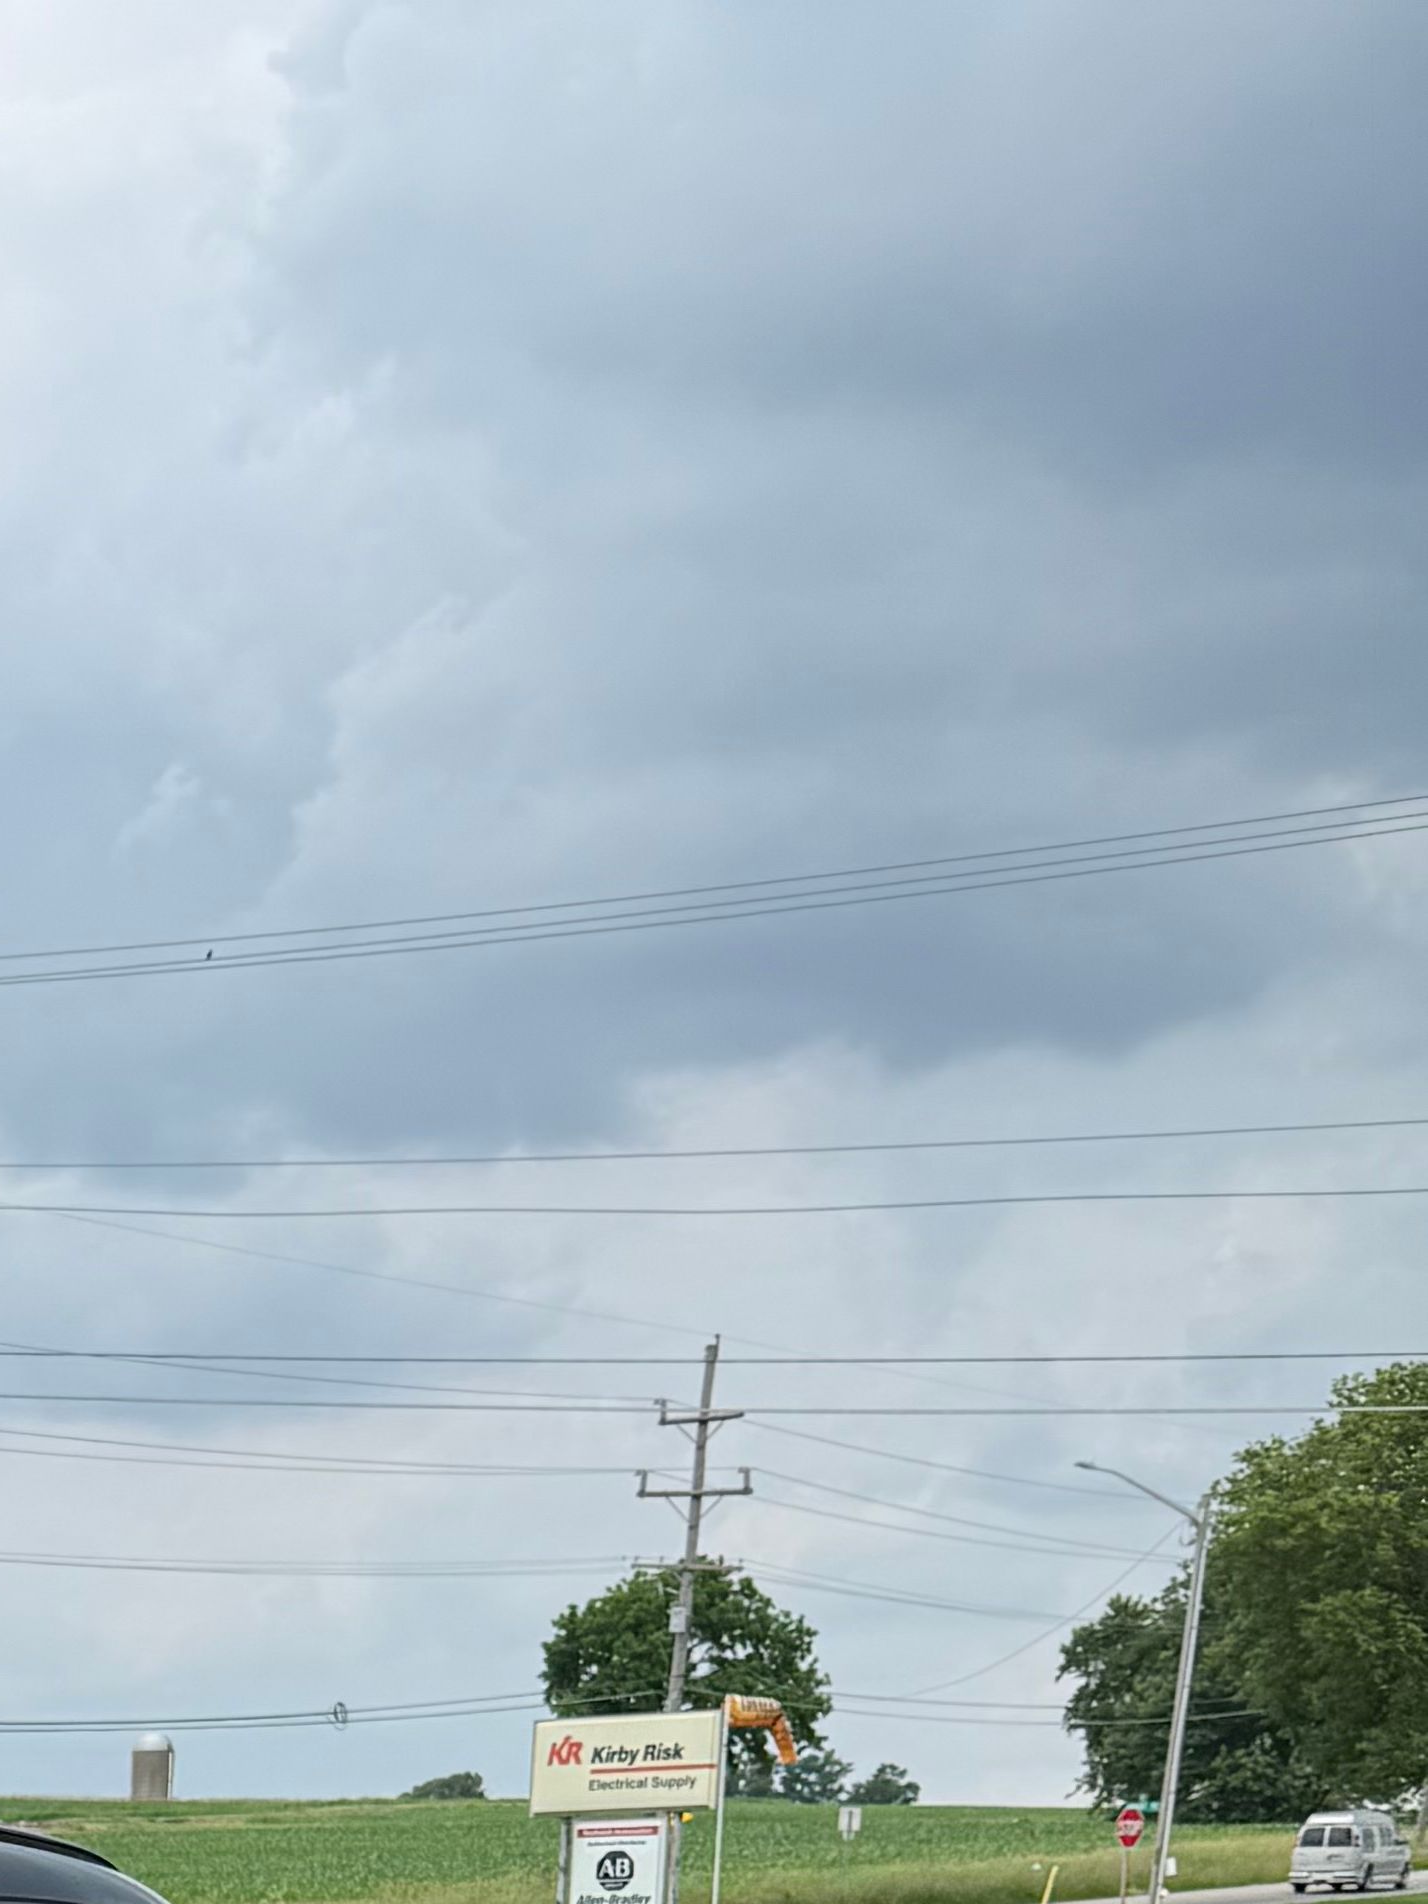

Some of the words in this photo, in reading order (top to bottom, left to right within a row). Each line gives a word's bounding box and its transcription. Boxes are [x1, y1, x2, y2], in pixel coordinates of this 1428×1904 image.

[547, 1735, 583, 1766] KR
[591, 1745, 639, 1766] Kirby
[644, 1743, 684, 1761] Risk
[589, 1776, 648, 1791] Electrical
[651, 1776, 696, 1790] Supply
[599, 1858, 630, 1878] AB
